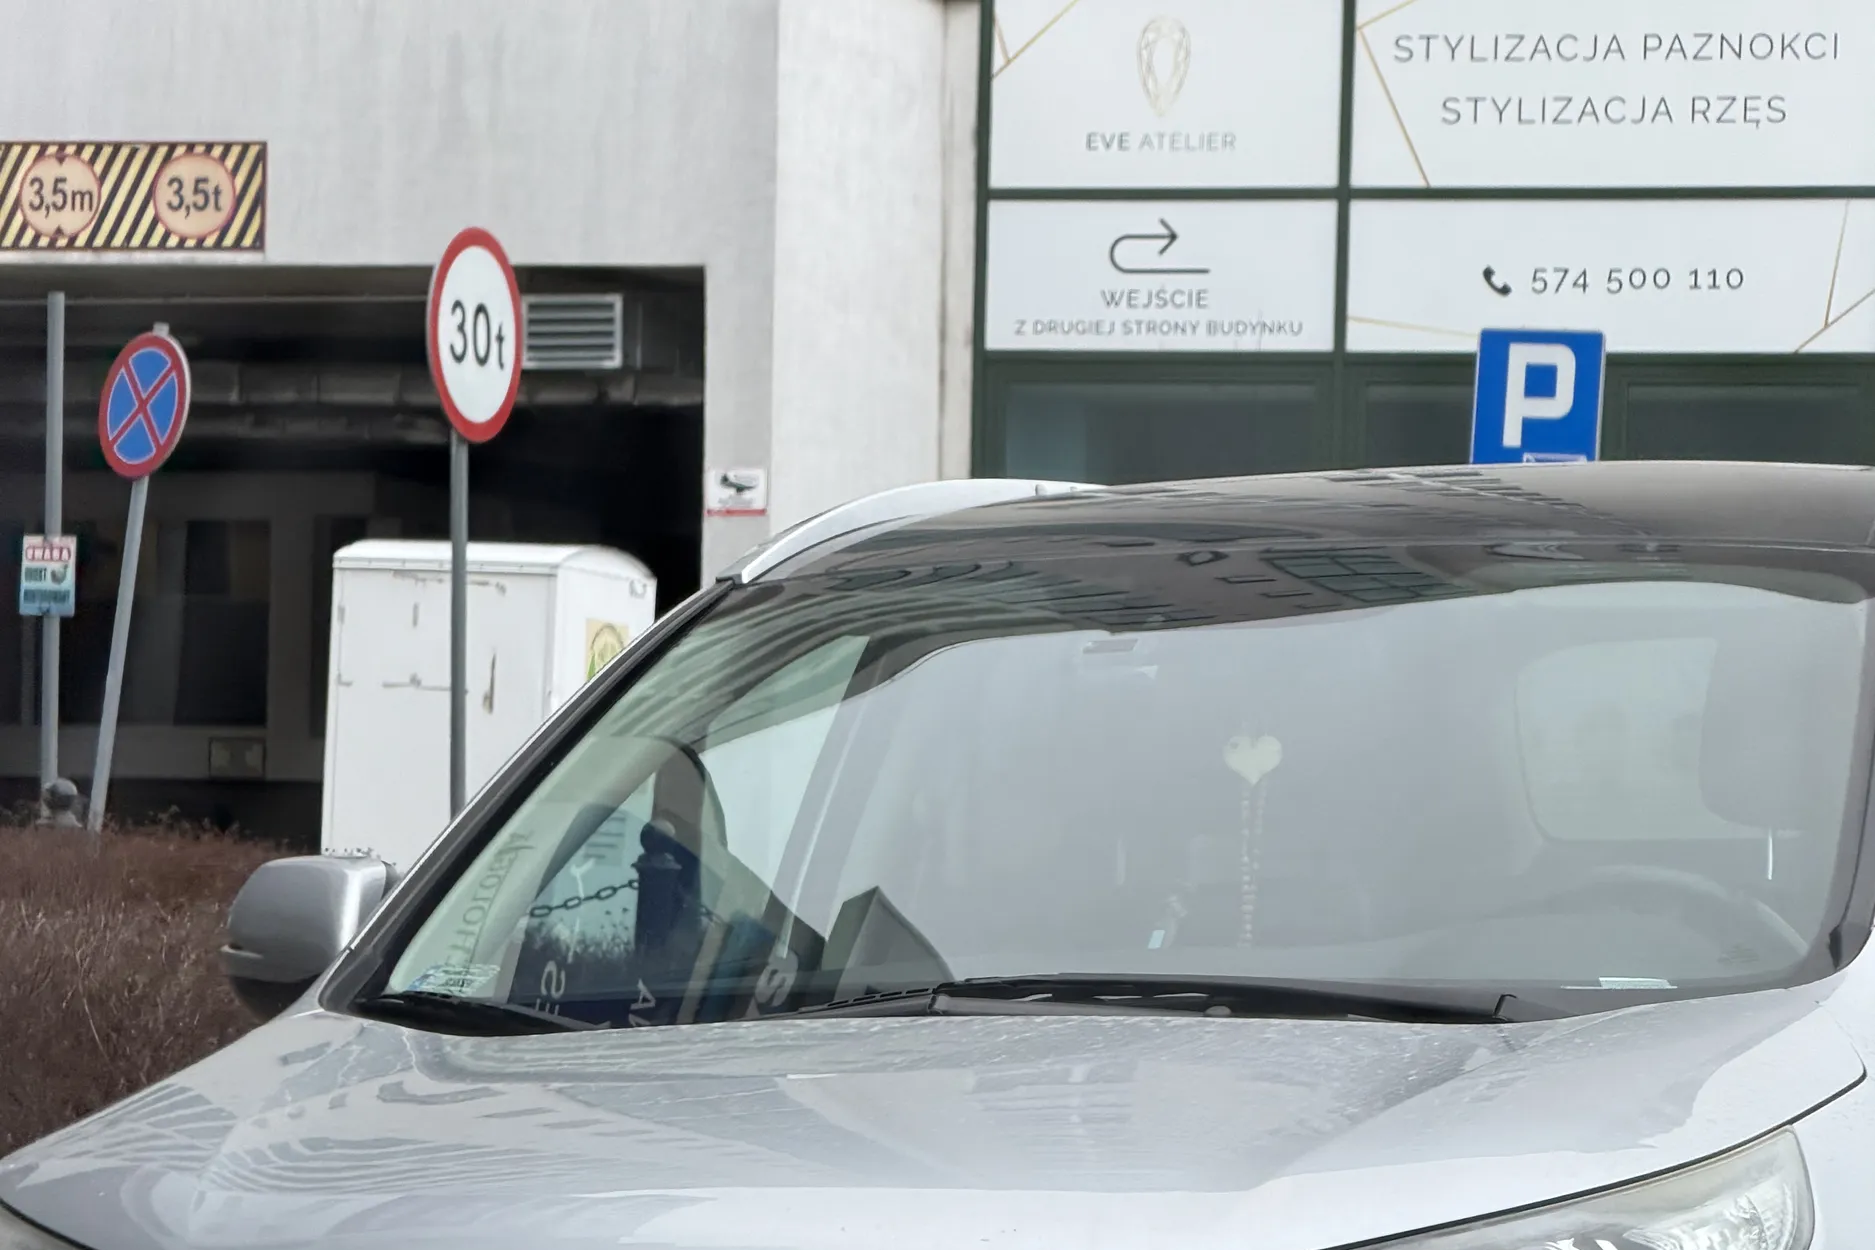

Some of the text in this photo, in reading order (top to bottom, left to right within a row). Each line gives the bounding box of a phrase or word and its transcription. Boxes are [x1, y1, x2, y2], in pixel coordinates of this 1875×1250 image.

[1393, 32, 1840, 62] STYLIZACJA PAZNOKCI
[1441, 96, 1788, 128] STYLIZACJA RZĘS
[1085, 131, 1237, 152] EVE ATELIER
[166, 176, 223, 219] 3,5t
[1531, 266, 1745, 294] 574 500 110
[1100, 284, 1209, 309] WEJŚCIE
[450, 299, 505, 371] 30t
[1013, 318, 1304, 336] Z DRUGIEJ STRONY BUDYNKU
[1502, 342, 1576, 448] P
